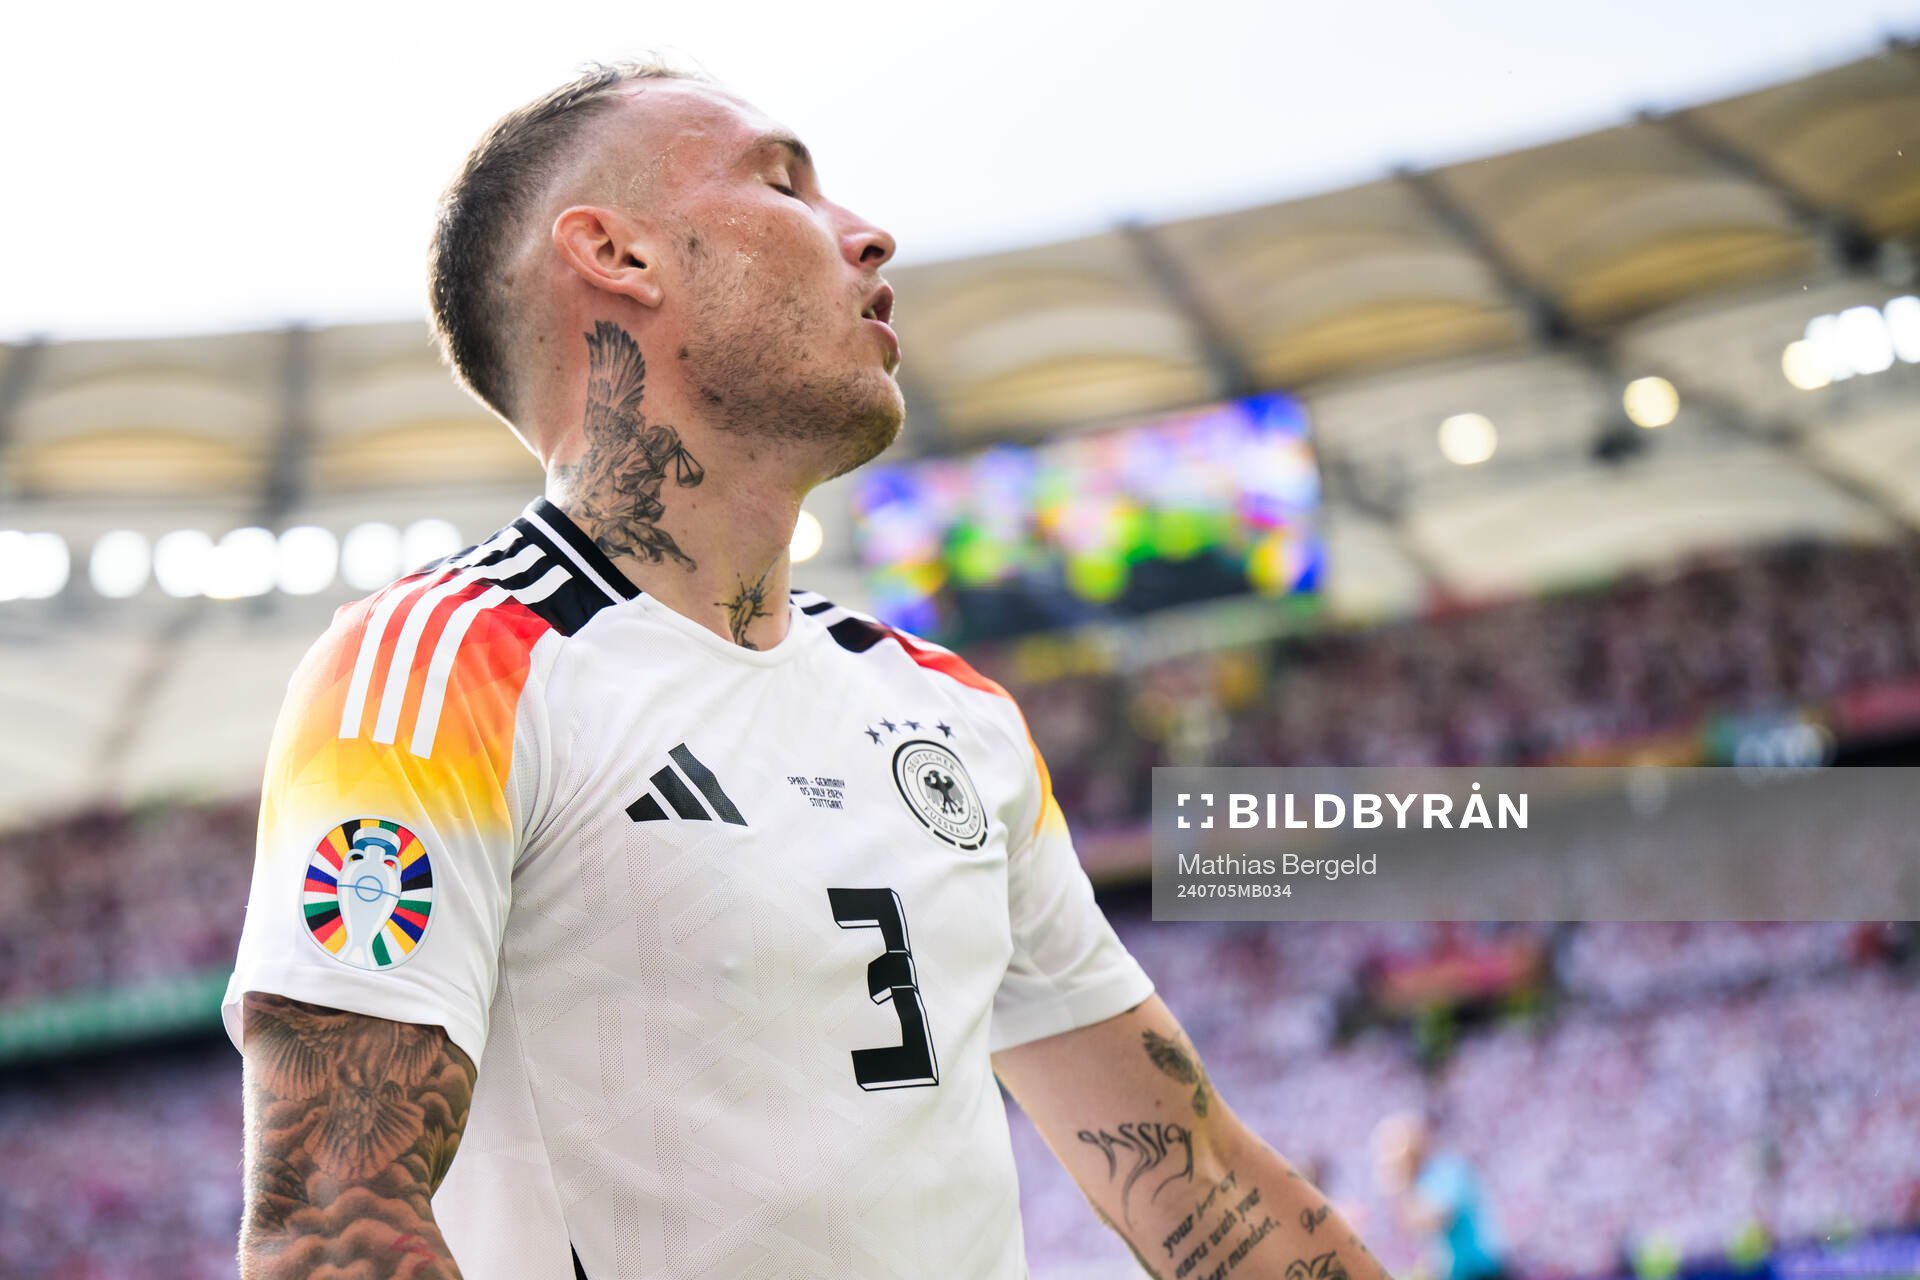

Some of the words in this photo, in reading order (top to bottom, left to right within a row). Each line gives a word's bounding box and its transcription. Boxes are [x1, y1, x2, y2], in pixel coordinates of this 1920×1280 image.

[907, 752, 955, 774] DEUTSCHER
[787, 776, 809, 786] SPAIN
[815, 777, 846, 789] GERMANY
[800, 787, 811, 796] 05
[810, 787, 826, 798] JULY
[826, 788, 844, 800] 2024
[809, 797, 844, 810] STUTTGART
[826, 888, 939, 1092] 3
[1163, 1213, 1194, 1258] your
[1209, 1208, 1237, 1246] with
